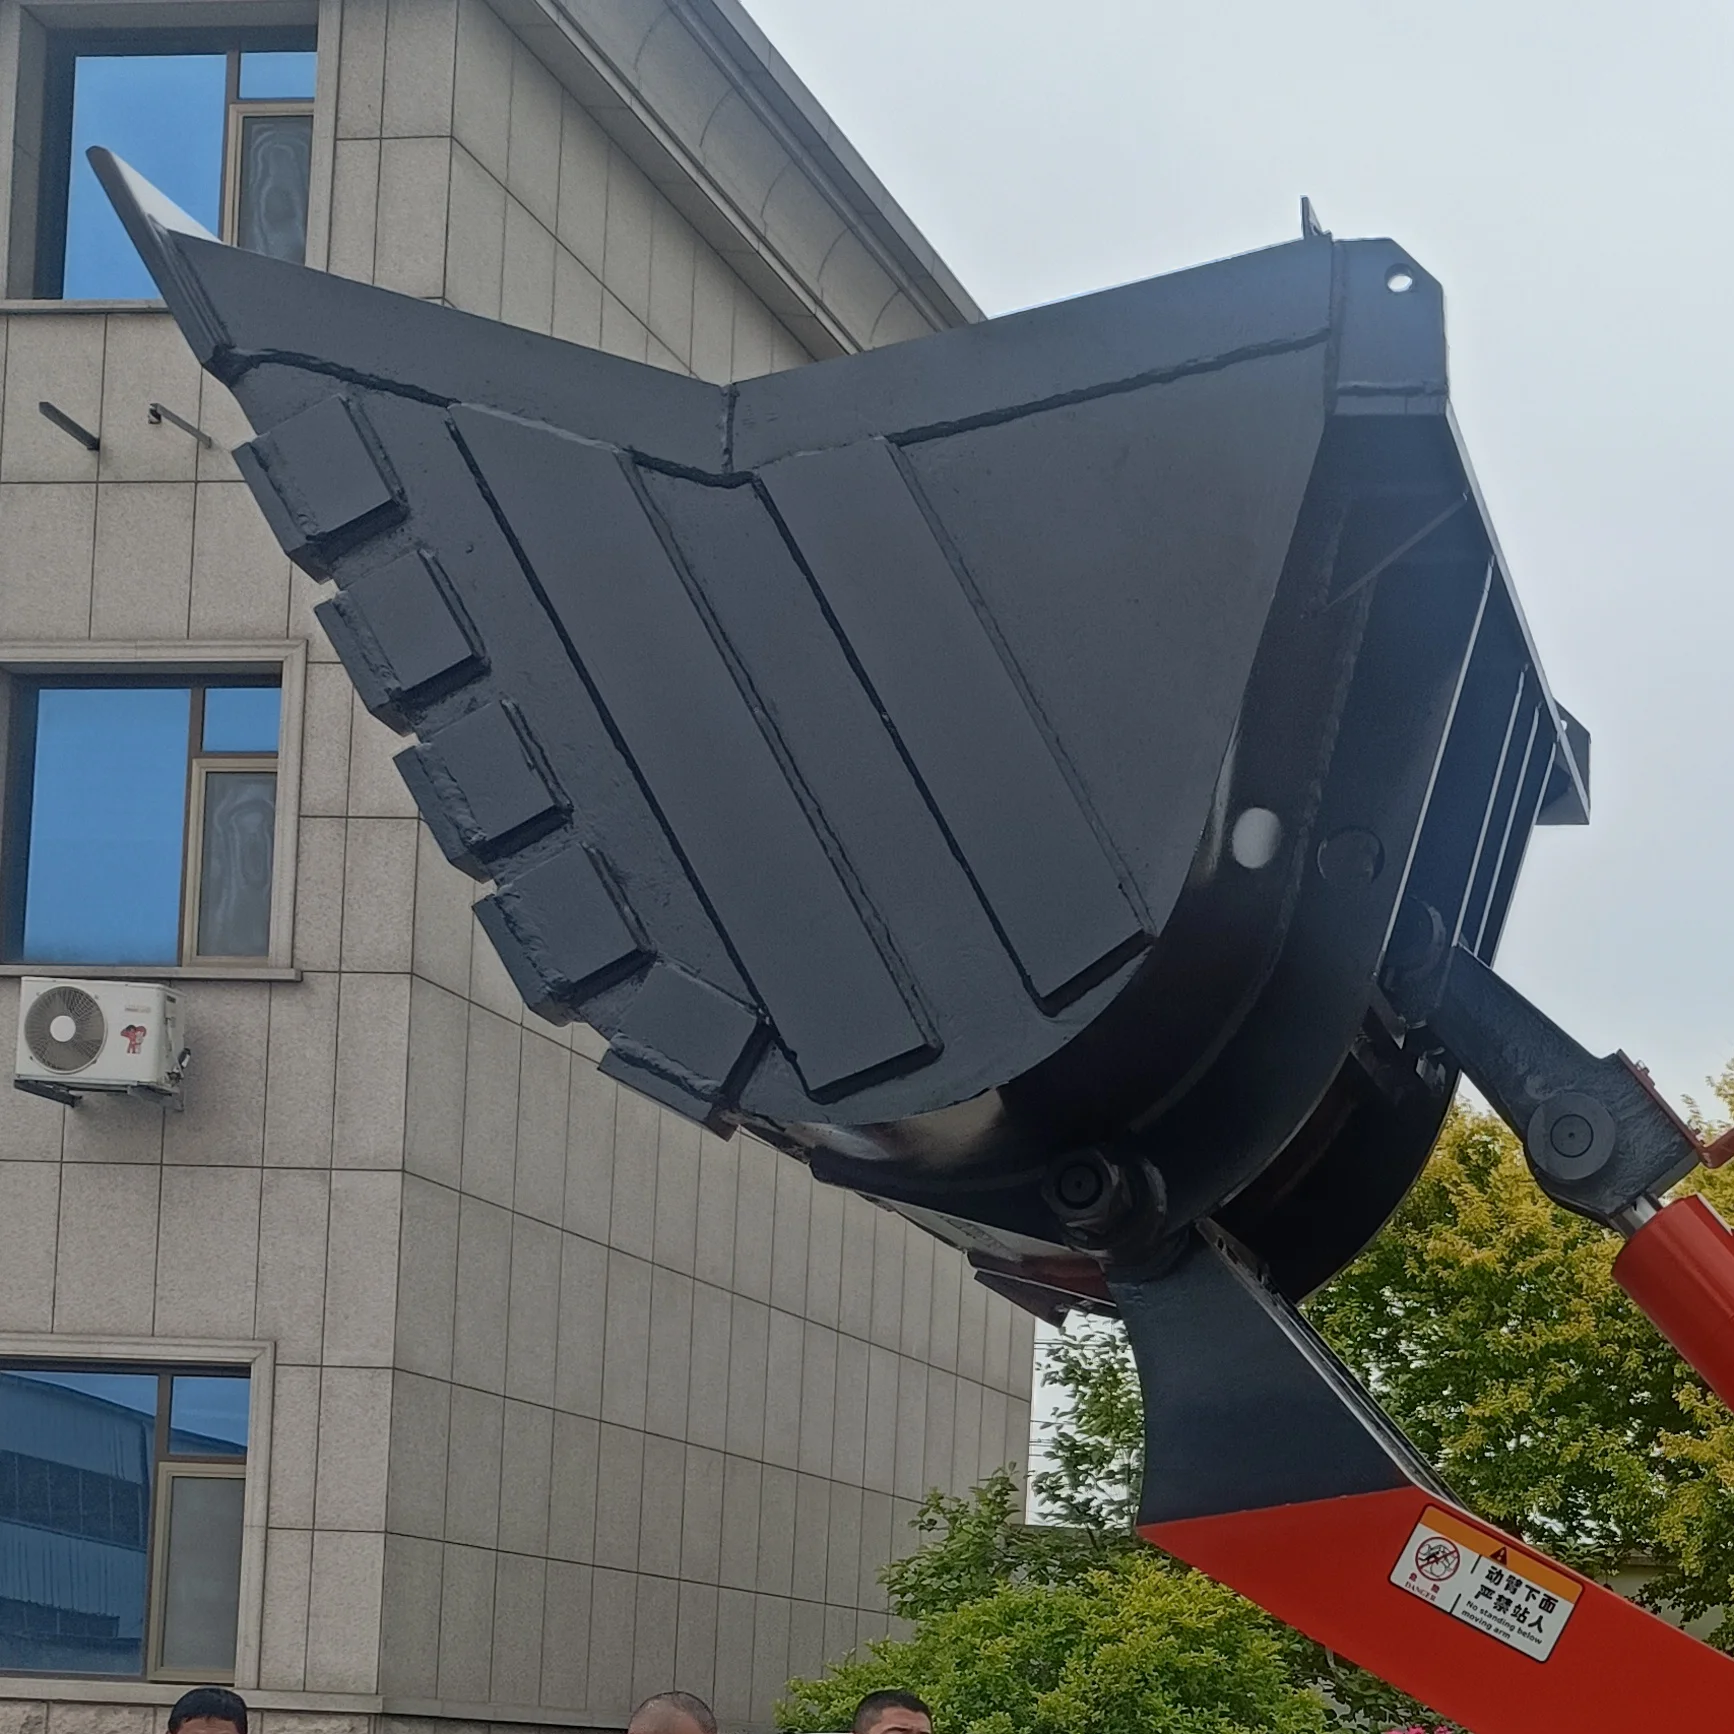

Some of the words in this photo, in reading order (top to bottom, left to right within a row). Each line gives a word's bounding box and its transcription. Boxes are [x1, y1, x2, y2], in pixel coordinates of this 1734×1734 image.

[1404, 1581, 1437, 1602] DANGER
[1474, 1584, 1544, 1634] 严禁站人
[1484, 1565, 1558, 1614] 动臂下面
[1461, 1609, 1492, 1631] moving
[1492, 1625, 1511, 1640] arm
[1466, 1600, 1478, 1611] No
[1478, 1606, 1516, 1632] standing
[1516, 1624, 1543, 1645] below
